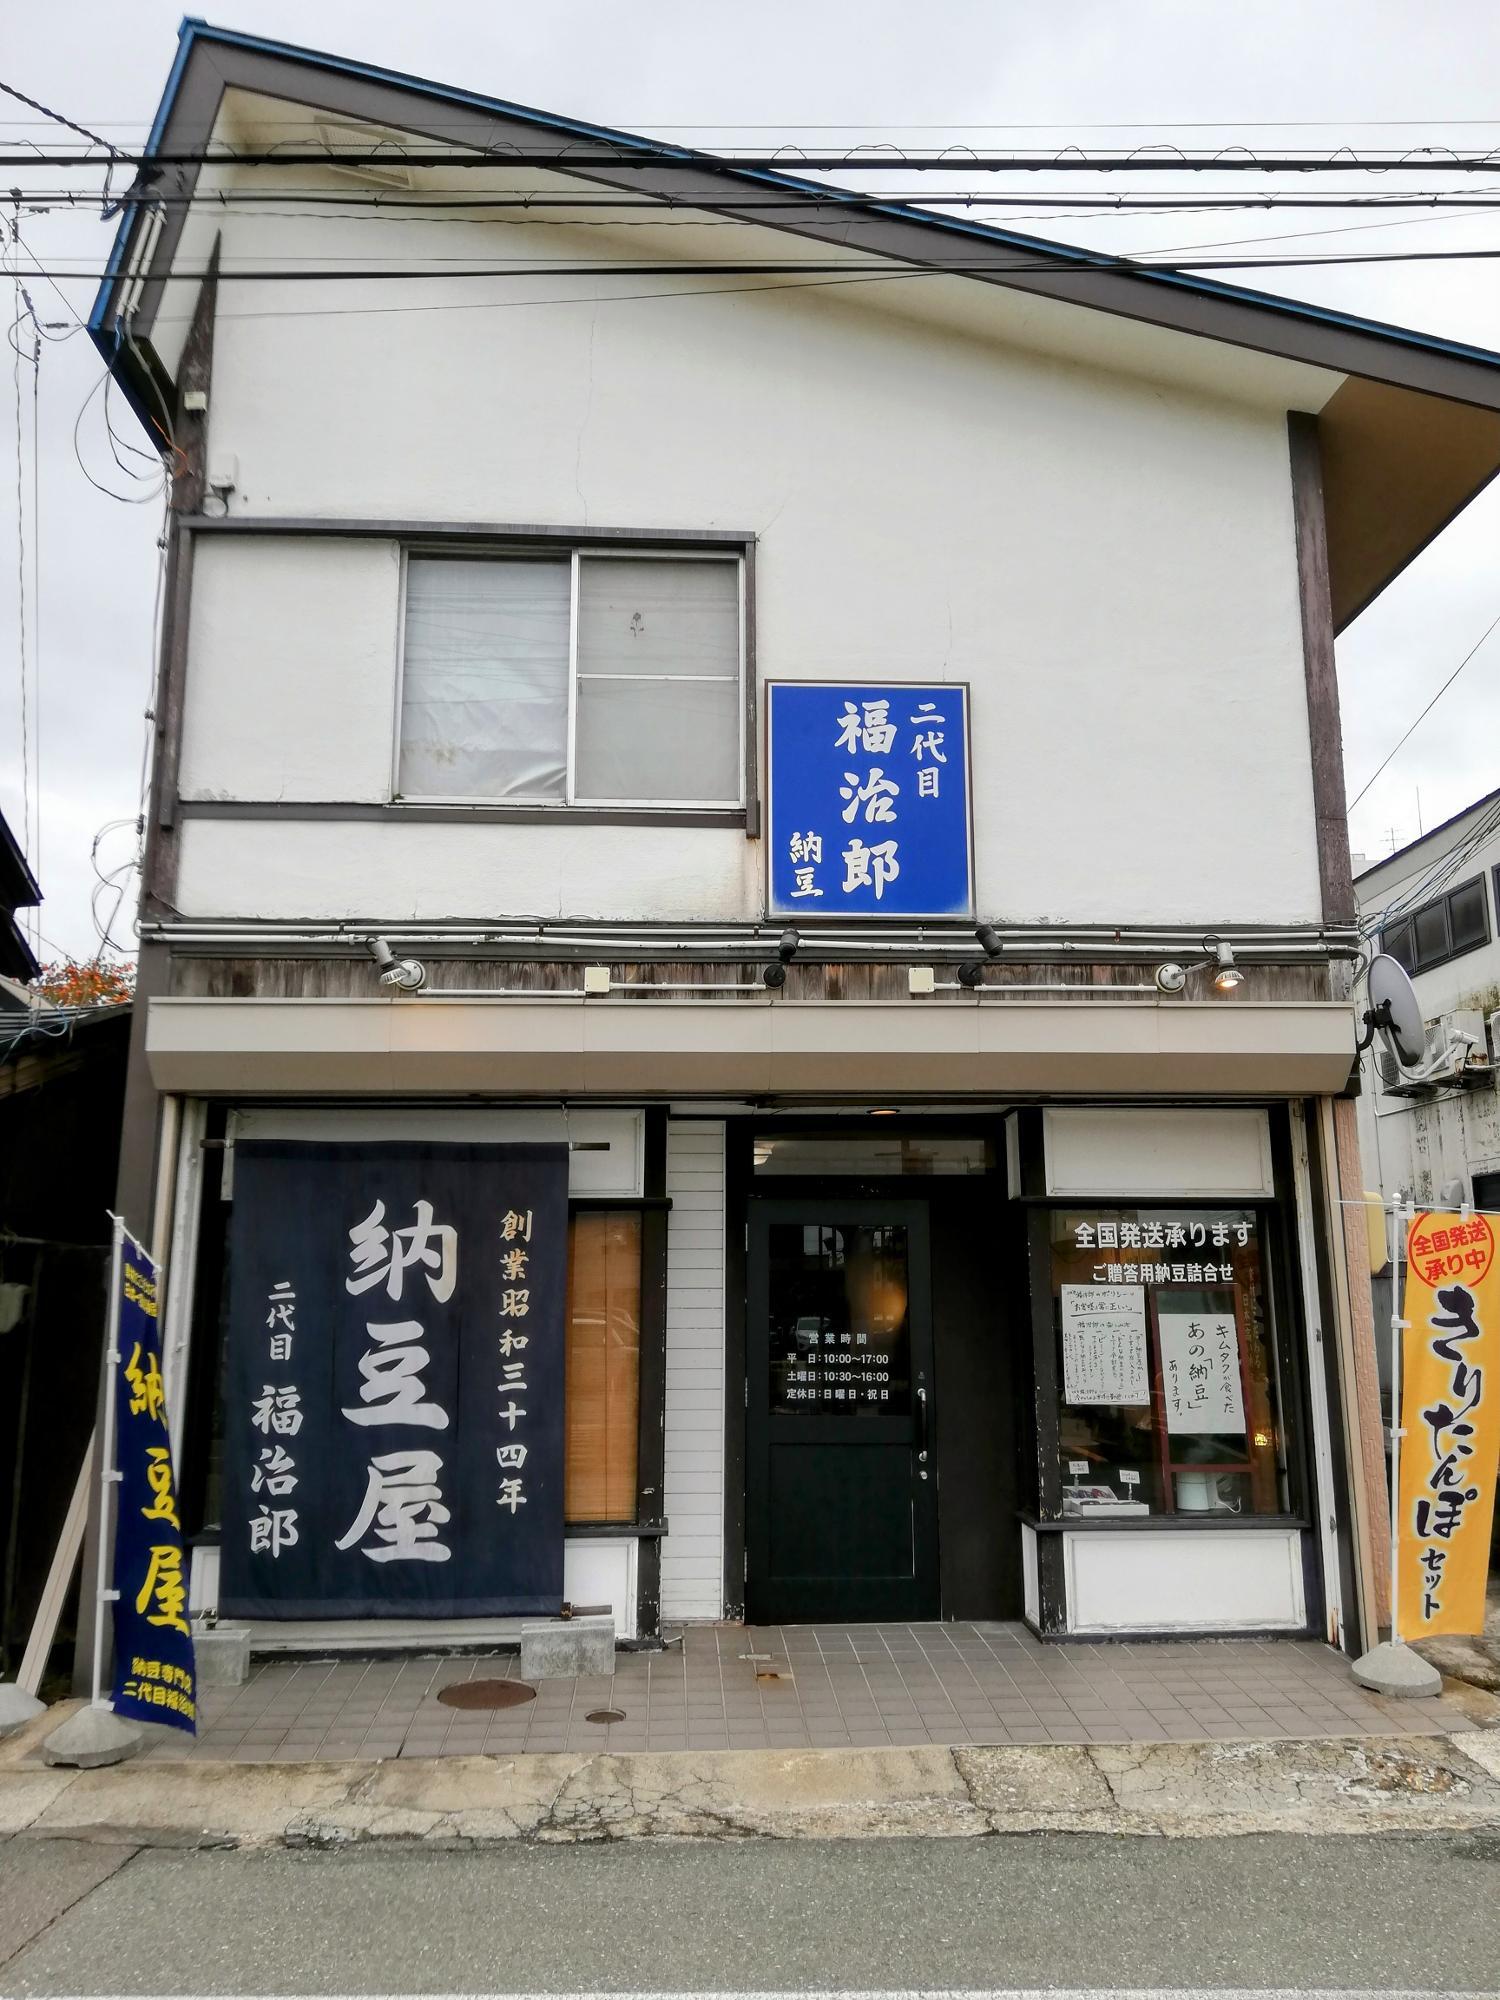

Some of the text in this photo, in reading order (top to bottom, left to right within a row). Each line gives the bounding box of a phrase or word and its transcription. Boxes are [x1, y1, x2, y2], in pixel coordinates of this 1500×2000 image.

[910, 702, 947, 798] 二代目
[834, 699, 900, 900] 福治郎
[789, 830, 824, 898] 納豆
[1074, 1221, 1253, 1249] 全国発送承ります
[1093, 1263, 1234, 1283] ご贈答用納豆詰合せ
[1413, 1220, 1488, 1257] 全国発送
[1425, 1248, 1486, 1281] 承り中
[334, 1199, 459, 1564] 納豆屋
[495, 1208, 533, 1515] 創業昭和三十四年
[808, 1333, 867, 1345] 営業時間
[1215, 1324, 1235, 1414] キムタクが食べた
[248, 1281, 304, 1558] 二代目 福治郎
[1416, 1285, 1482, 1620] きりたんぽ セット
[124, 1341, 191, 1638] 納豆屋
